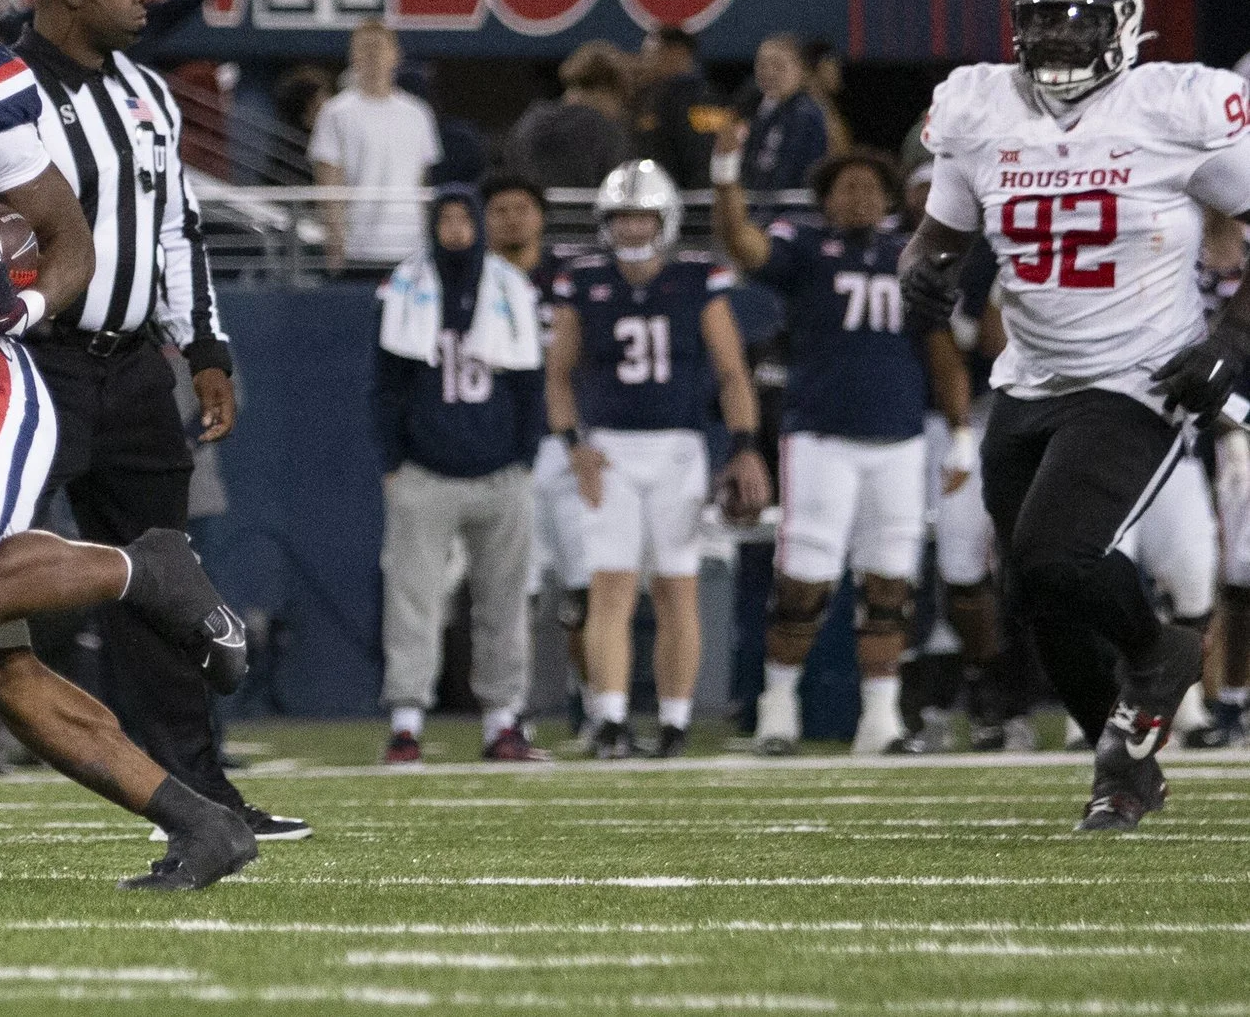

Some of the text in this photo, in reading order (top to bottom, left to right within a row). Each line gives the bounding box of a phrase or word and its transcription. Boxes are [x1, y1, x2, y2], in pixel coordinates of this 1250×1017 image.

[59, 103, 76, 125] S
[1224, 92, 1250, 139] 9
[1000, 168, 1132, 188] HOUSTON
[1001, 188, 1118, 288] 92
[614, 314, 671, 384] 31
